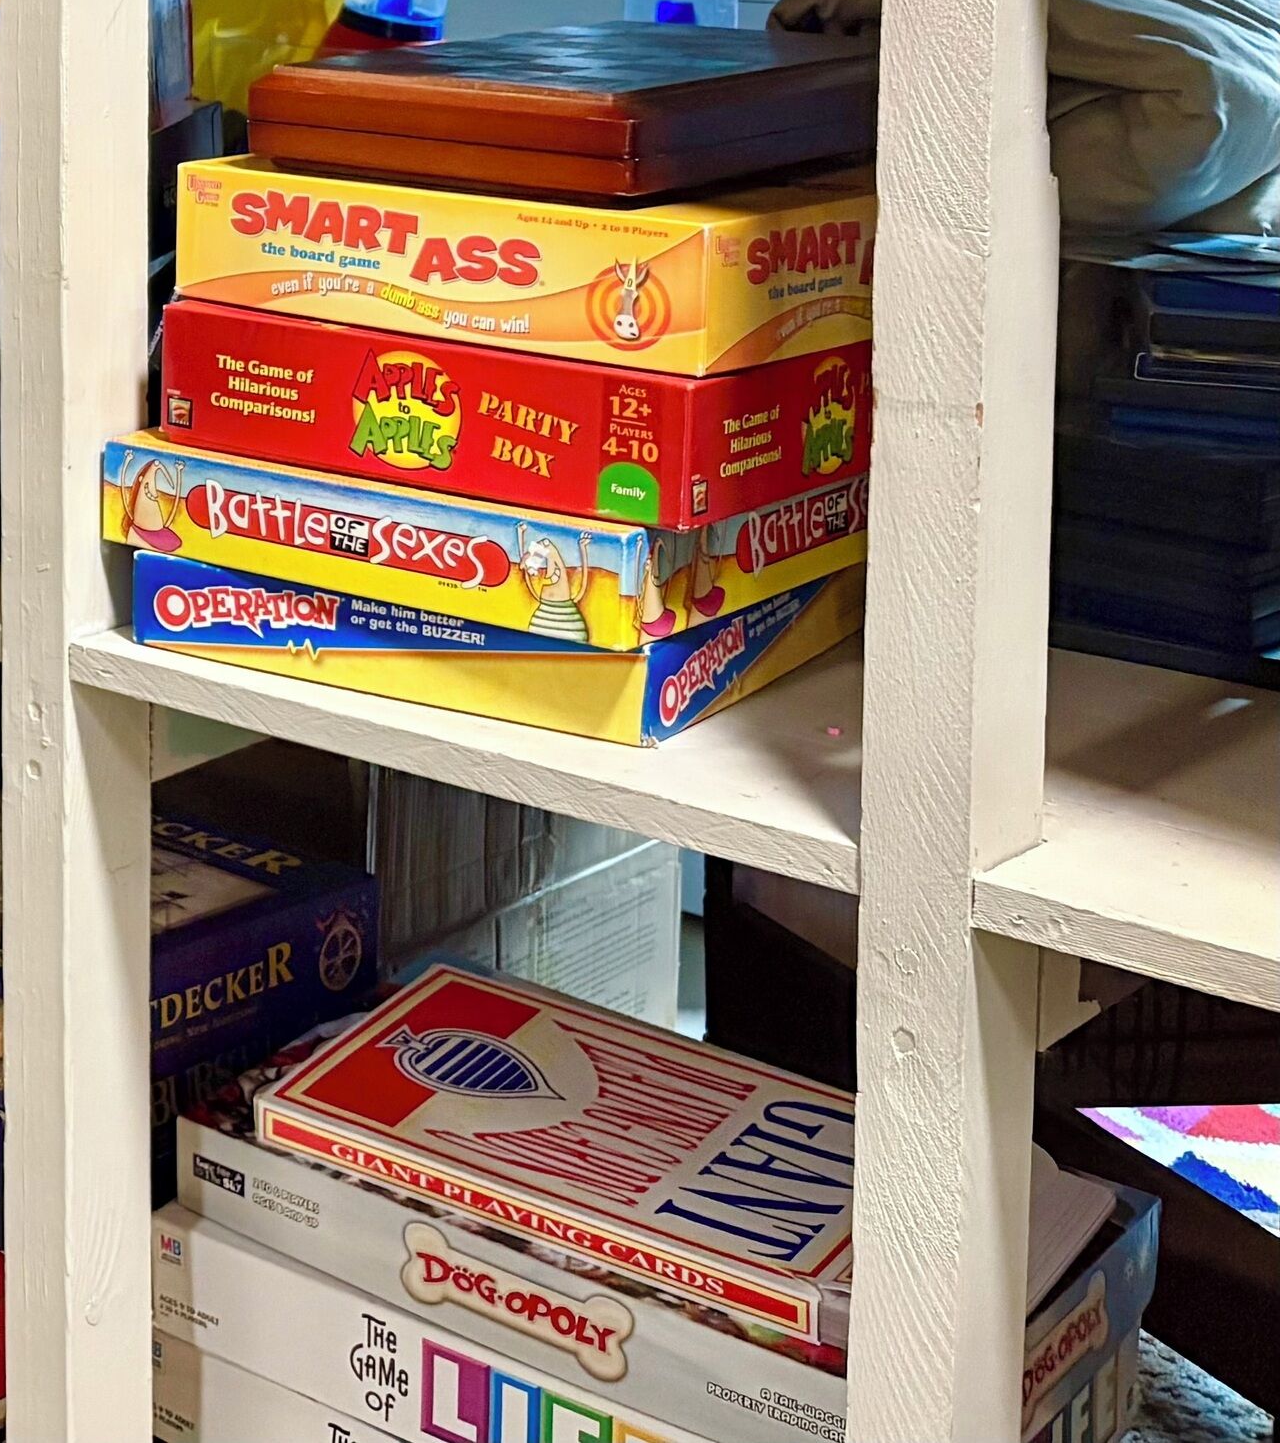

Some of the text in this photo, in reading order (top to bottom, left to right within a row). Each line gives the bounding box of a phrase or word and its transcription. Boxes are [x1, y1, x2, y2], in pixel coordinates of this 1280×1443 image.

[230, 190, 418, 254] SMART
[409, 236, 541, 286] ASS
[272, 273, 529, 334] even if you're a dumb ass you can win!
[216, 354, 314, 384] The Game of
[352, 348, 460, 416] APPLES
[228, 375, 298, 400] Hilarious
[619, 384, 646, 398] AGES
[210, 391, 315, 424] Comparisons!
[398, 401, 410, 414] to
[478, 391, 580, 445] PARTY
[610, 396, 651, 419] 12+
[350, 401, 457, 471] APPLES
[610, 423, 653, 439] PLAYERS
[491, 436, 554, 479] BOX
[602, 437, 658, 463] 4-10
[611, 484, 645, 499] Family
[206, 479, 328, 547] Battle
[334, 518, 360, 535] OF
[332, 534, 366, 553] THE
[370, 517, 488, 589] Sexes
[155, 586, 339, 631] OPERATION
[351, 599, 464, 626] Make him better
[351, 616, 485, 645] or get the BUZZER!
[331, 1142, 724, 1296] GIANT PLAYING CARDS
